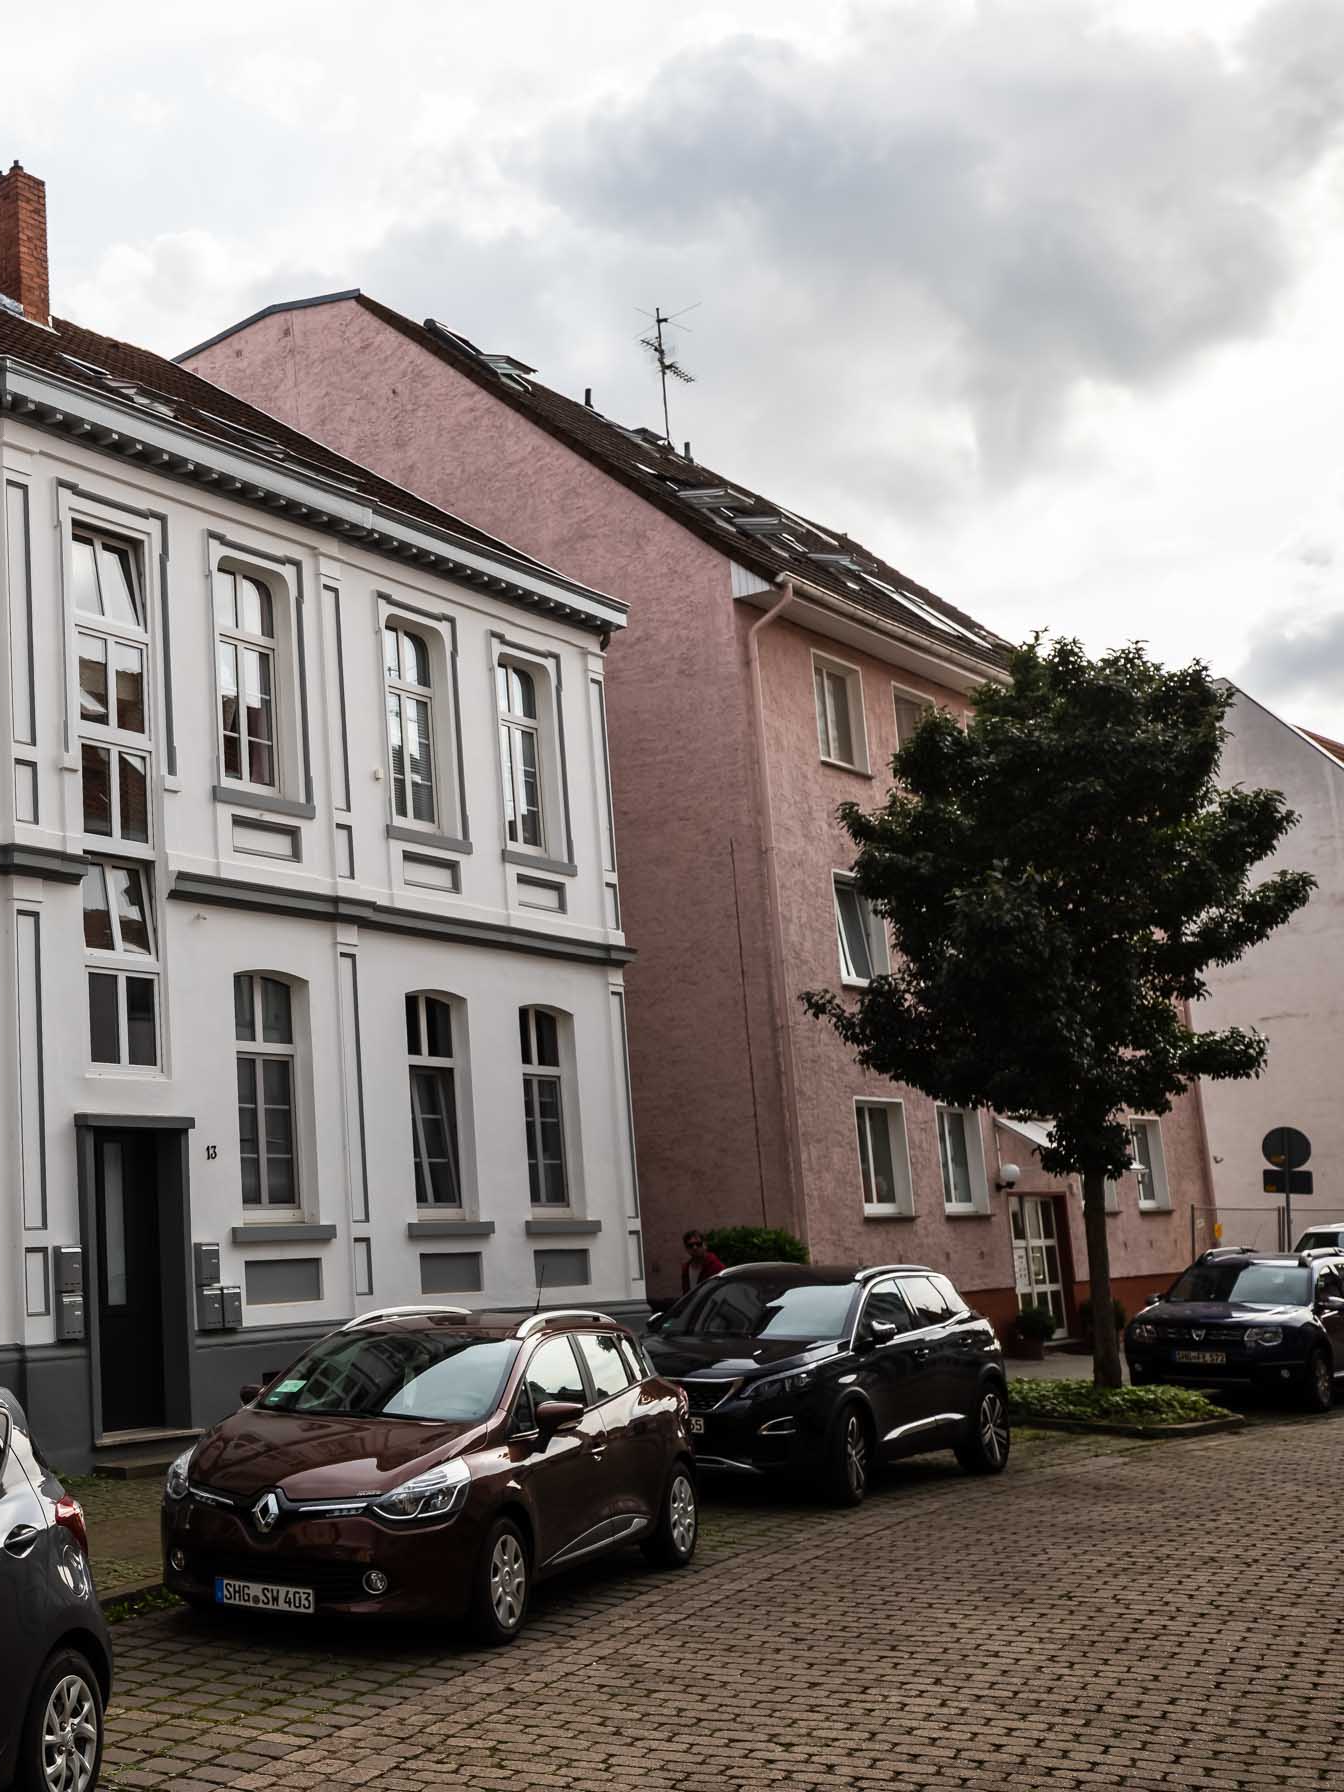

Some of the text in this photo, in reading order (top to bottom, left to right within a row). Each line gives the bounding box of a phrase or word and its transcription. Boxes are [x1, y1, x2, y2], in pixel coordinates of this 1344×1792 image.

[206, 1145, 217, 1160] 13
[224, 1582, 311, 1609] SHG SW 403
